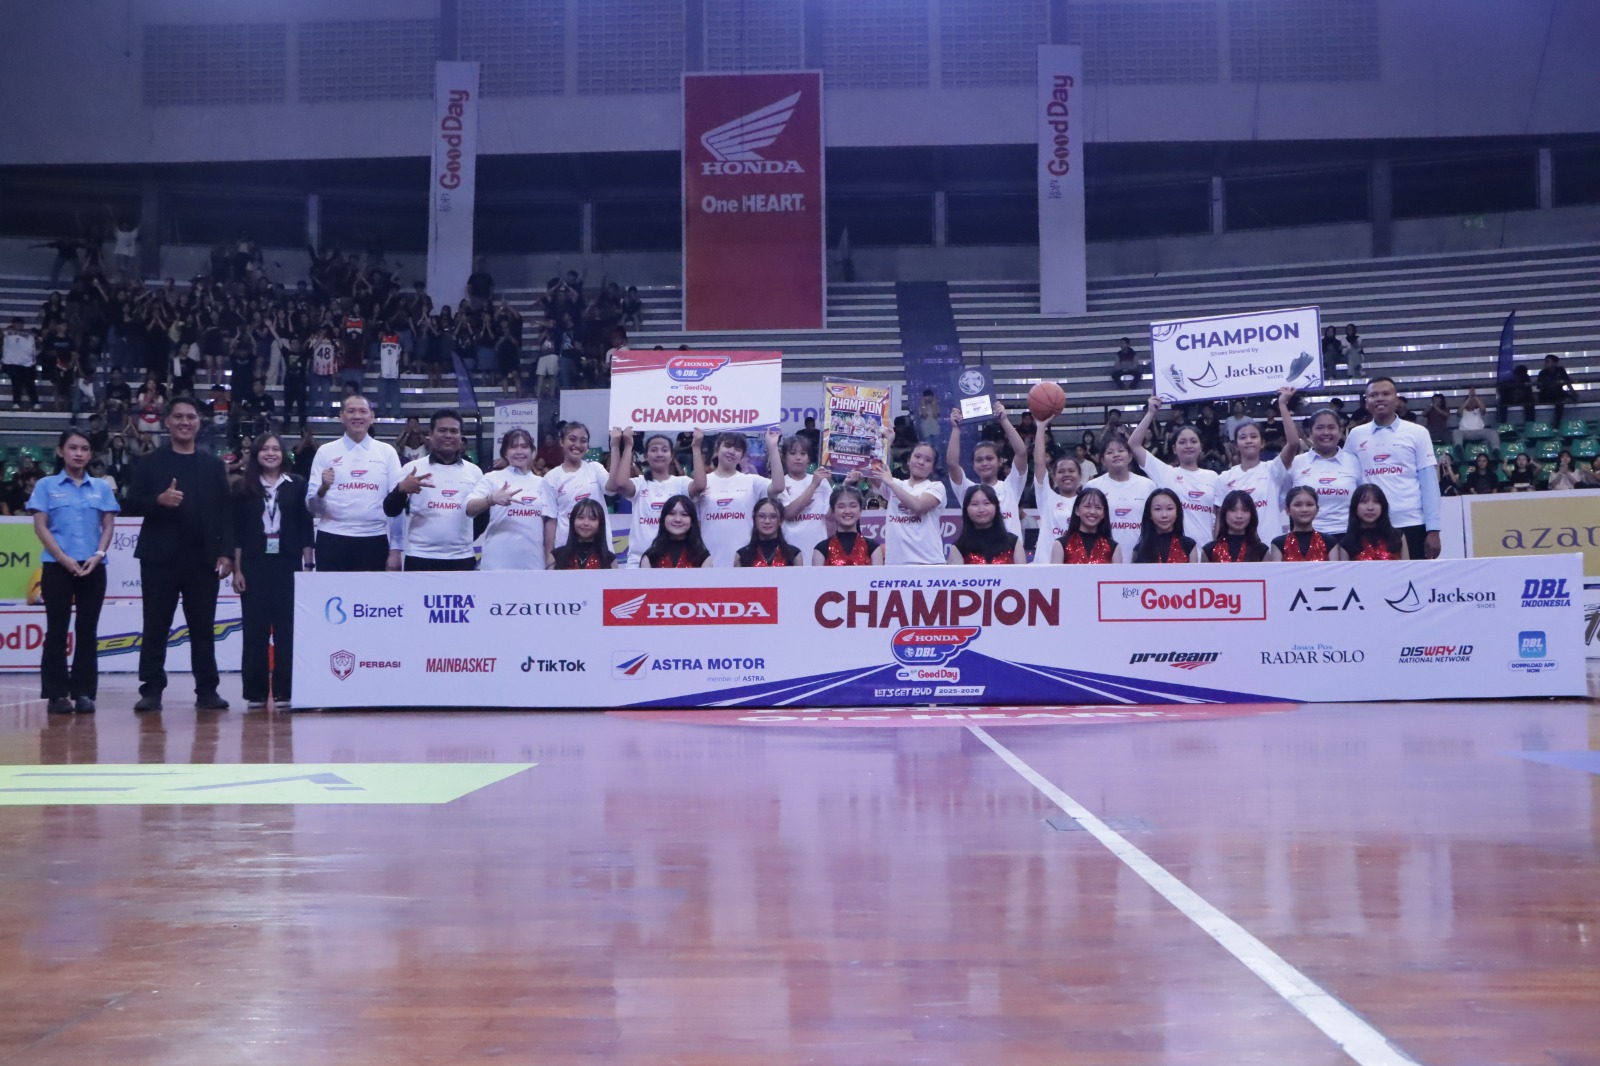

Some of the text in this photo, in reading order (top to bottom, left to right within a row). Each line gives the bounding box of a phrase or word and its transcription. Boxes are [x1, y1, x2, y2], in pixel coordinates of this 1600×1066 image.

[701, 160, 805, 175] HONDA
[701, 193, 805, 213] One HEART.
[1176, 322, 1300, 351] CHAMPION
[316, 347, 331, 360] 48
[1225, 364, 1284, 379] Jackson
[667, 395, 718, 406] GOES TO
[829, 396, 883, 415] CHAMPION
[631, 408, 759, 424] CHAMPIONSHIP
[338, 482, 379, 491] CHAMPION
[1316, 488, 1349, 496] AMPION
[508, 509, 541, 517] CHAMPIO
[1181, 502, 1212, 513] HAMPION
[706, 512, 745, 521] CHAMPION
[113, 533, 139, 550] KOP
[870, 579, 1001, 588] CENTRAL JAVA-SOUTH
[1521, 579, 1570, 599] DBL
[424, 594, 475, 608] ULTRA
[1428, 587, 1496, 603] Jackson
[647, 601, 770, 618] HONDA
[814, 588, 1060, 628] CHAMPION
[1521, 599, 1571, 607] INDONESIA
[353, 603, 403, 618] Biznet
[428, 609, 470, 623] MILK
[915, 634, 960, 642] HONDA
[1521, 638, 1543, 648] DBL
[914, 647, 937, 658] DBL
[1129, 651, 1219, 664] proteam
[1260, 649, 1365, 665] RADAR SOLO
[1400, 645, 1474, 657] DISWAY.ID
[359, 660, 401, 668] PERBASI
[425, 658, 497, 673] MAINBASKET
[537, 659, 586, 672] TikTok
[651, 658, 765, 670] ASTRA MOTOR
[874, 687, 933, 698] LET'S GET LOUD
